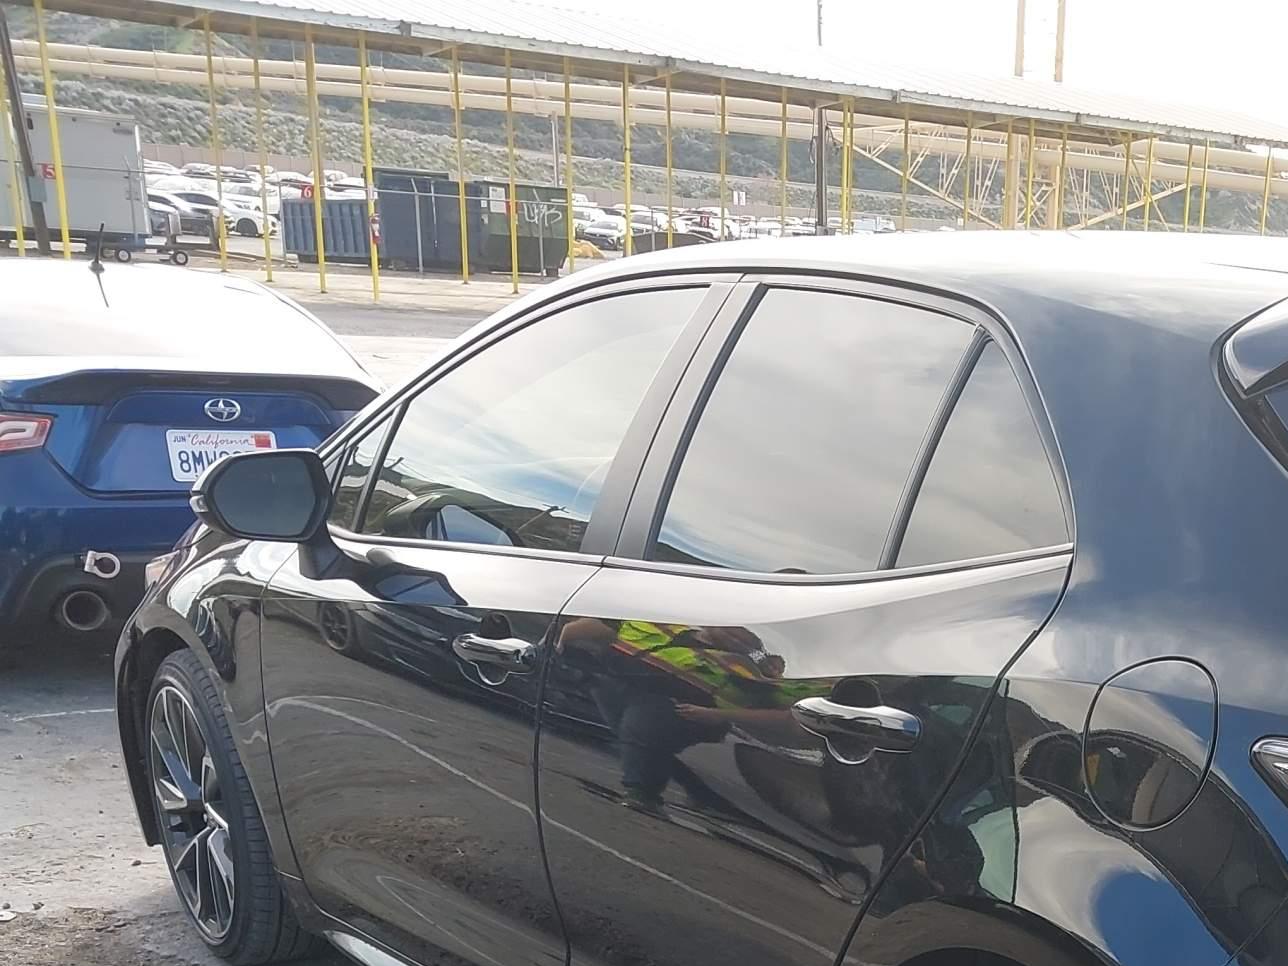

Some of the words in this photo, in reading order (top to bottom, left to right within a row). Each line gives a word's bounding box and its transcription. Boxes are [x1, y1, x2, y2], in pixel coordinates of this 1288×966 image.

[45, 164, 56, 178] 5
[303, 186, 312, 198] 6
[173, 435, 186, 443] JUN
[190, 432, 250, 448] California
